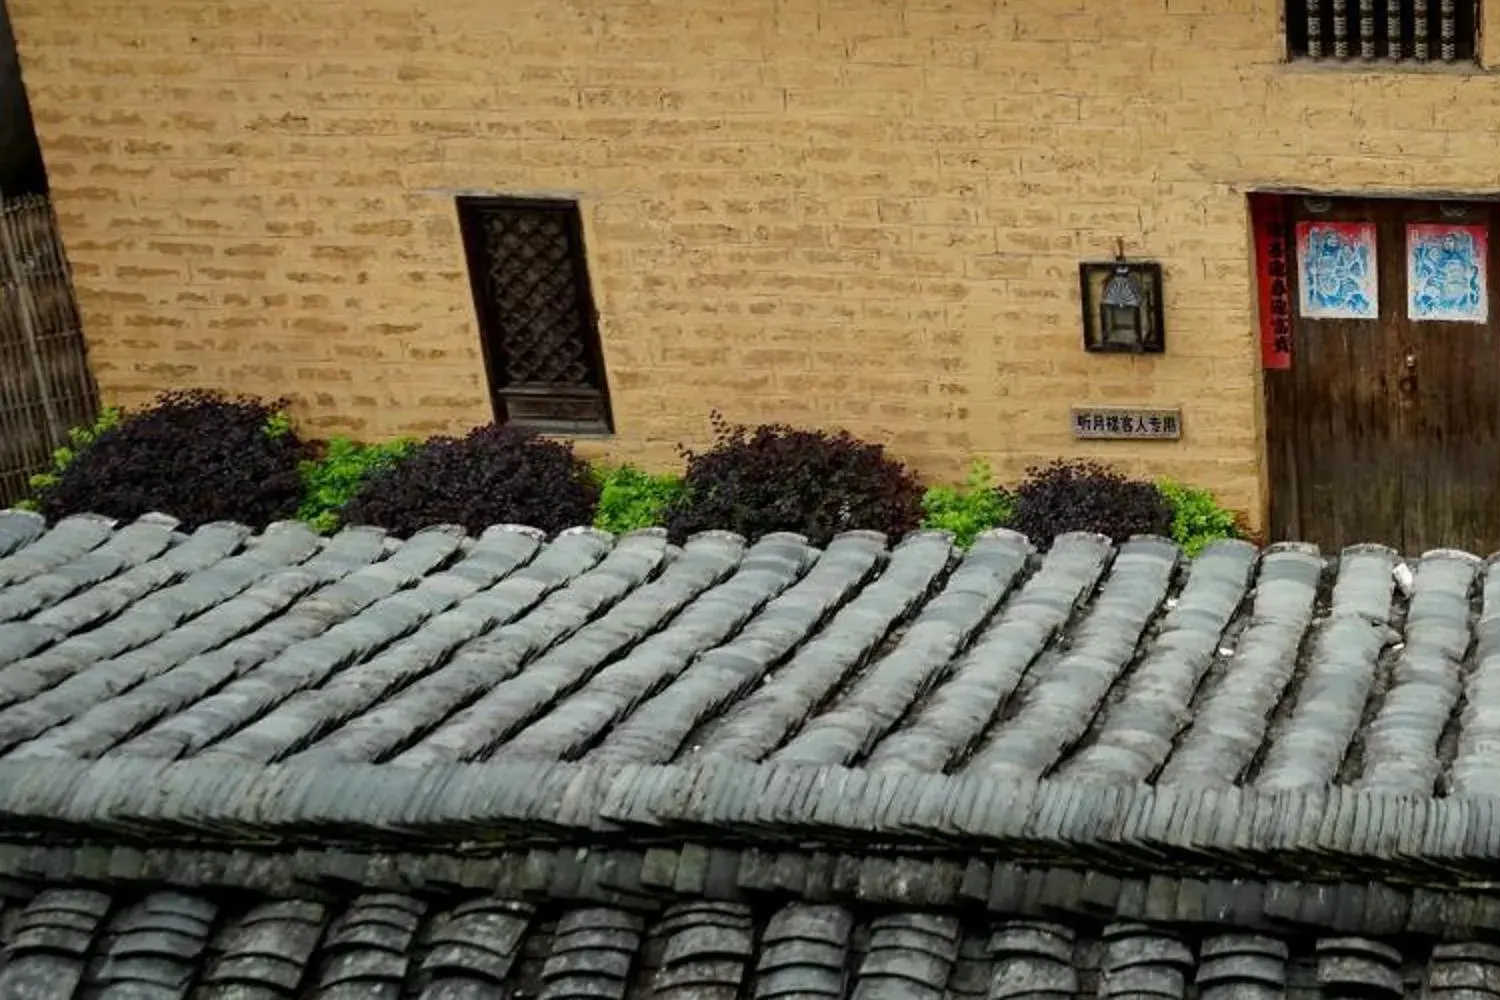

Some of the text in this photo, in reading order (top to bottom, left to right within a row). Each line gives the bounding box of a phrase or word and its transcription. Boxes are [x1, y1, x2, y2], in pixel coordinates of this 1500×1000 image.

[1077, 414, 1177, 433] 听月楼客人专用
